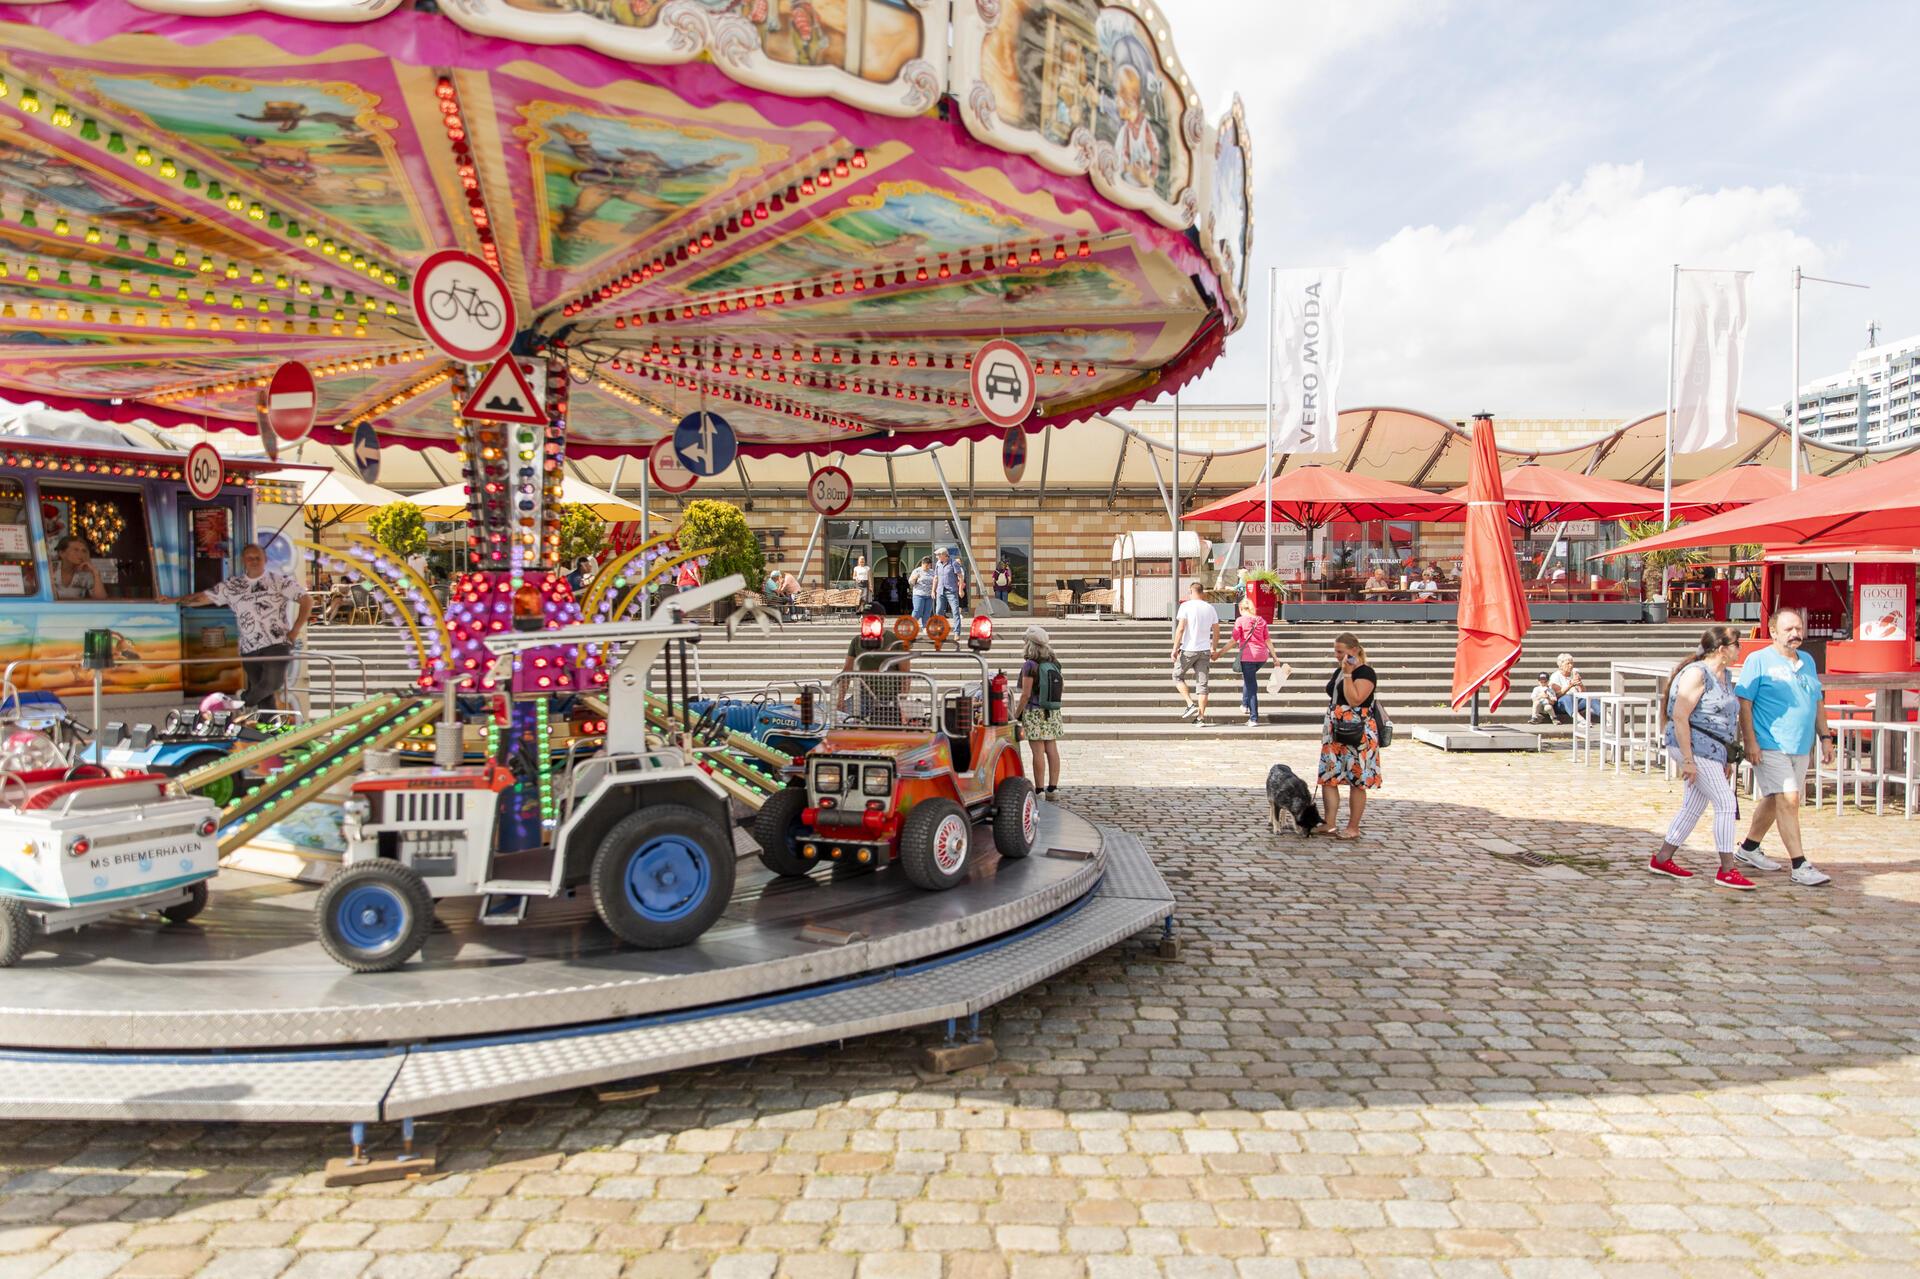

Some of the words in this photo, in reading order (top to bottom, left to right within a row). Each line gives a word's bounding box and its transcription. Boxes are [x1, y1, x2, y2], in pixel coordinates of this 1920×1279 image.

[1302, 281, 1322, 365] MODA
[1299, 373, 1319, 444] VERO
[816, 479, 846, 500] 3.80m
[878, 525, 926, 536] EINGANG
[1247, 523, 1281, 534] GOSH
[1863, 587, 1904, 599] GOSCH
[771, 717, 798, 727] POLIZEI
[114, 842, 202, 865] BREMERHAVEN
